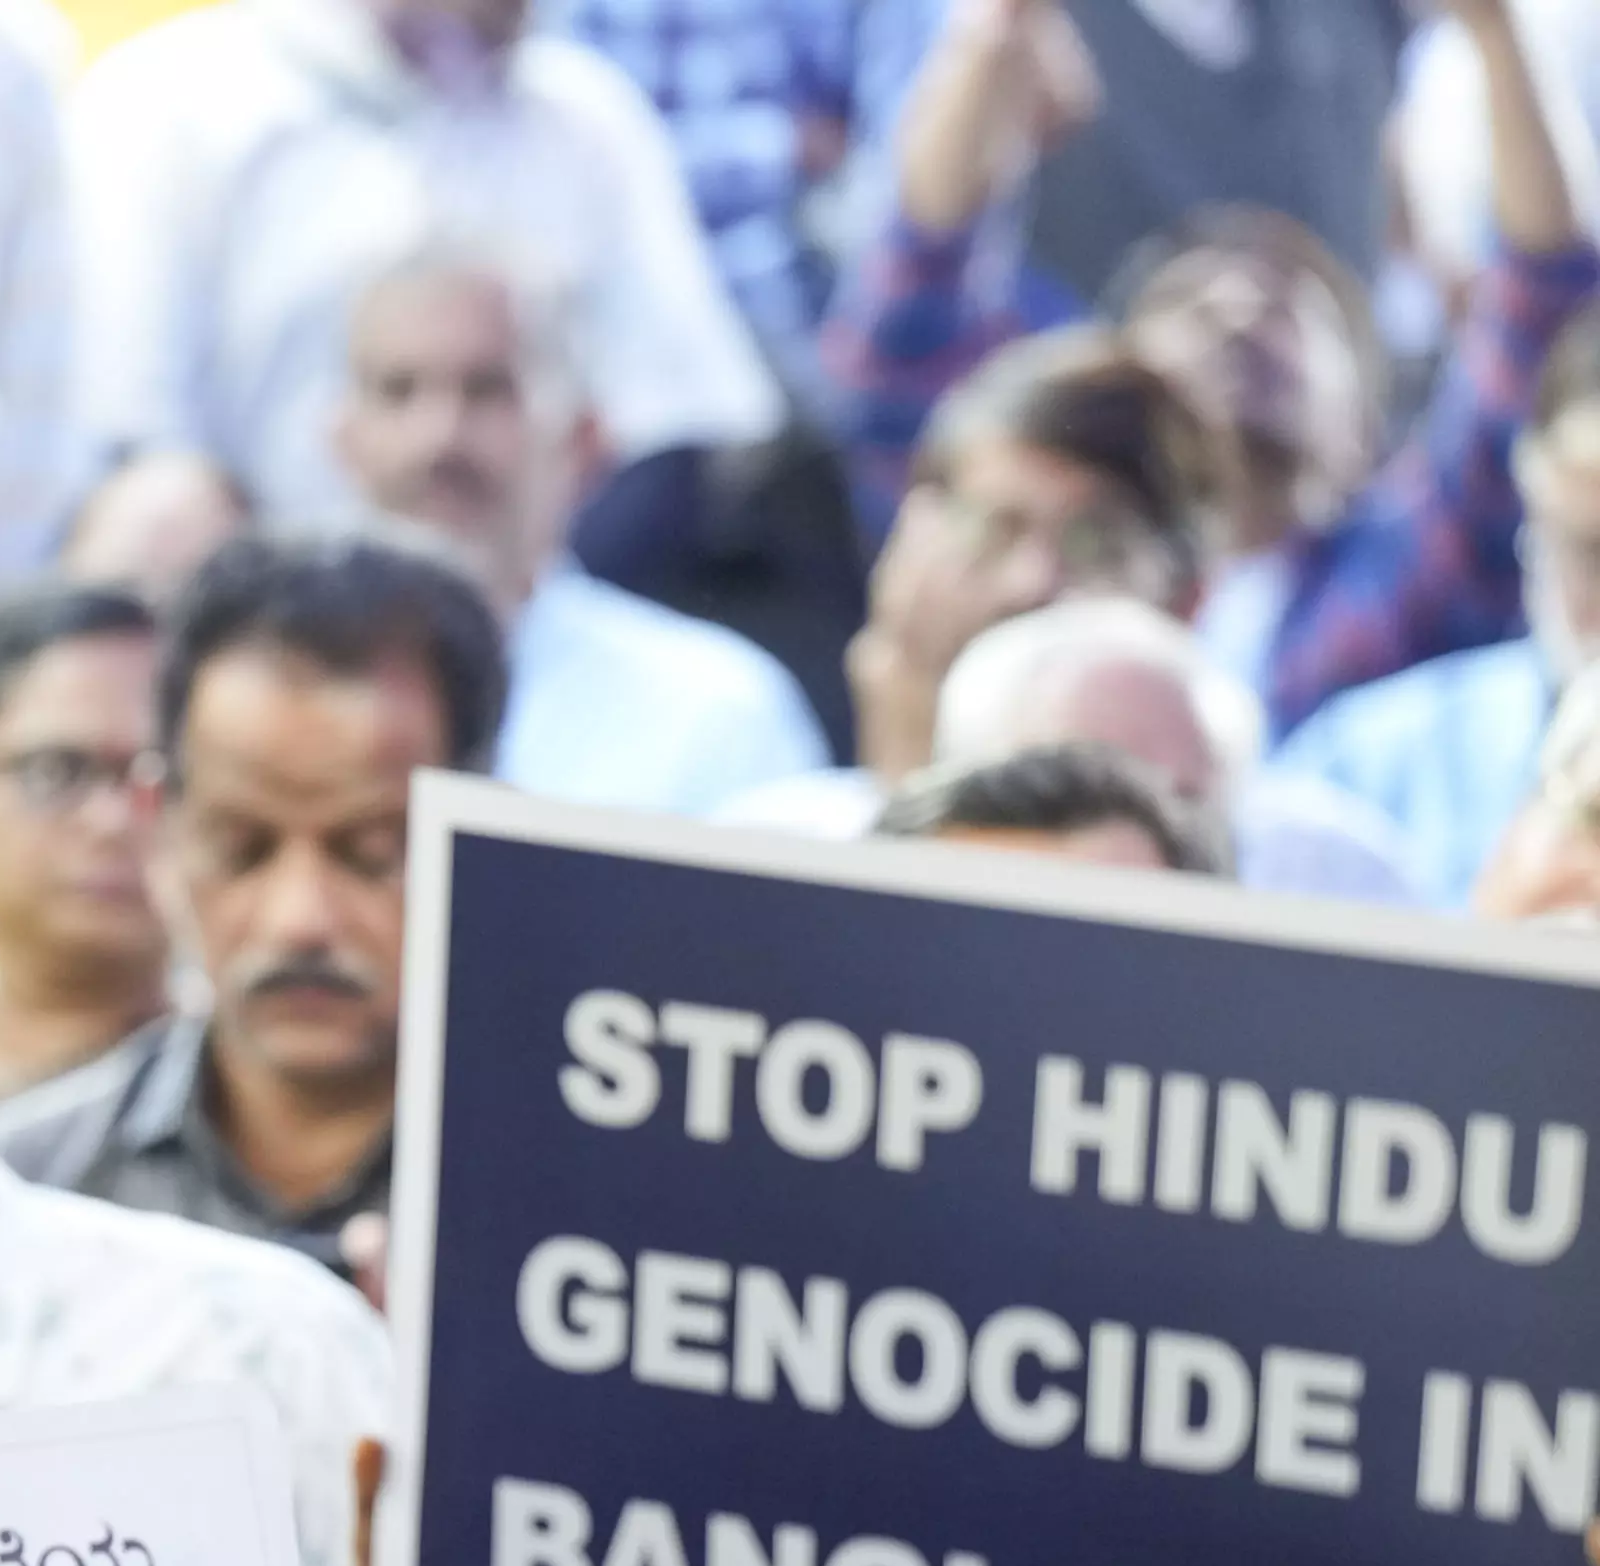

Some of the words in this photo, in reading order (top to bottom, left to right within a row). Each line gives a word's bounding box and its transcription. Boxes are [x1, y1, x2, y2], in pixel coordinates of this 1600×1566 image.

[560, 990, 983, 1171] STOP
[1030, 1055, 1587, 1263] HINDU
[517, 1237, 1364, 1494] GENOCIDE
[1416, 1372, 1600, 1534] IN
